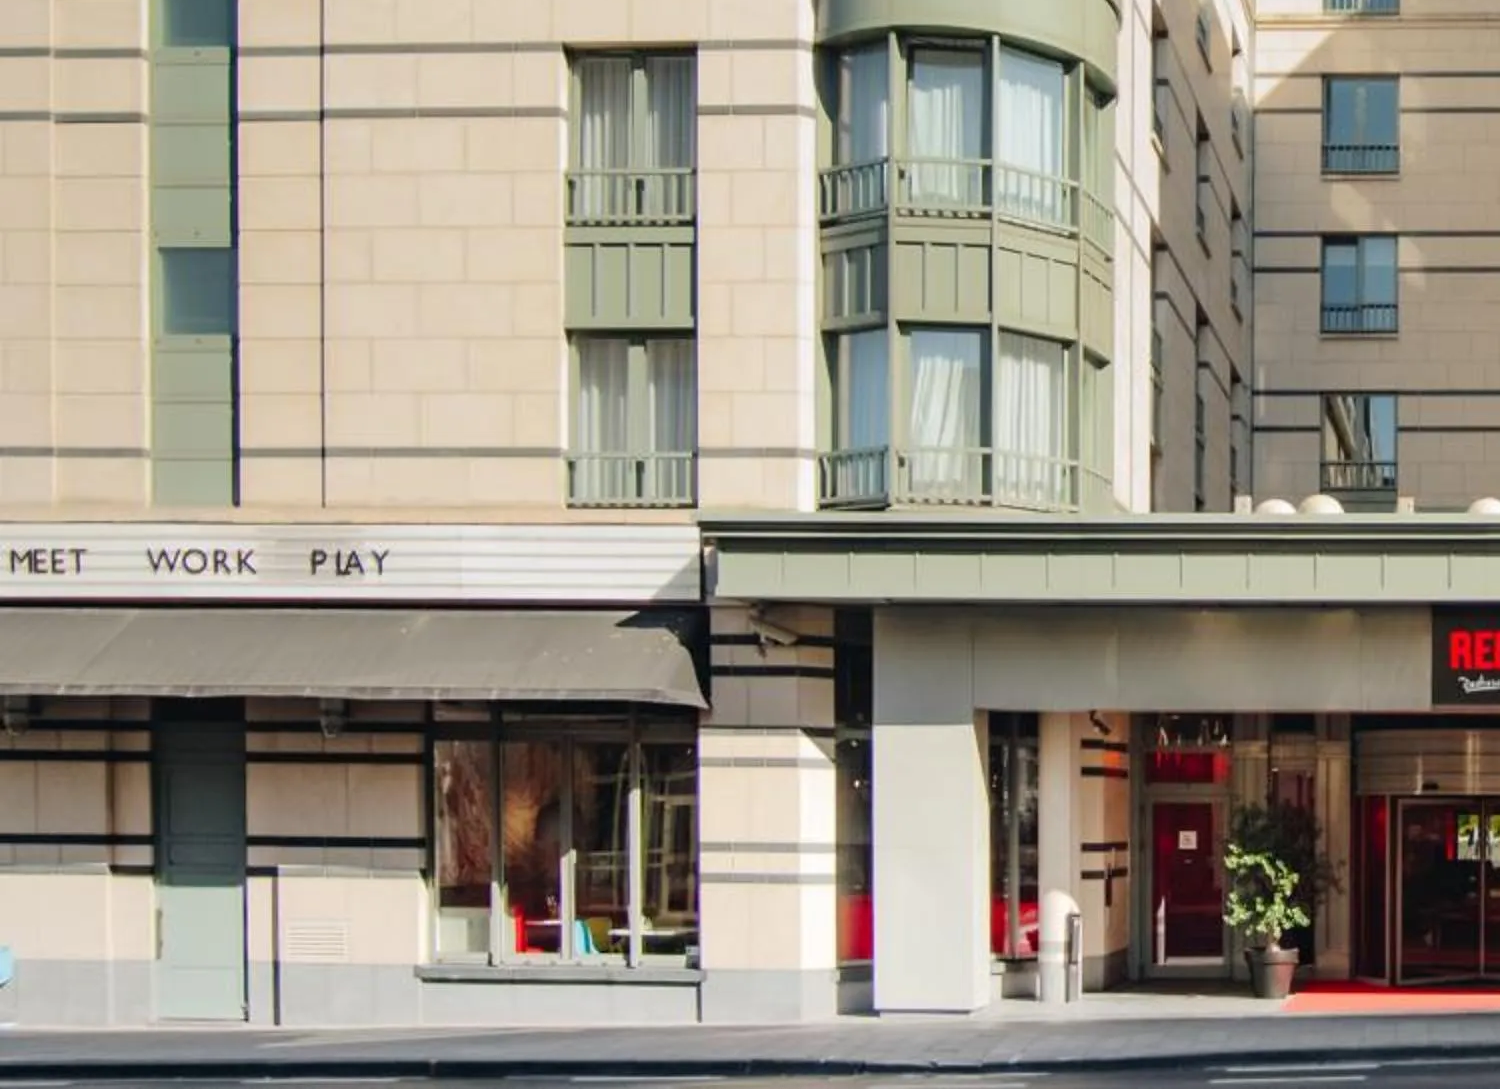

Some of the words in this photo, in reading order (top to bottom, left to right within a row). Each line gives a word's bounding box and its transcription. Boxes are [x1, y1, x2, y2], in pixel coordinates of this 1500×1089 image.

[10, 548, 87, 575] MEET
[147, 548, 257, 575] WORK
[310, 549, 390, 576] PLAY
